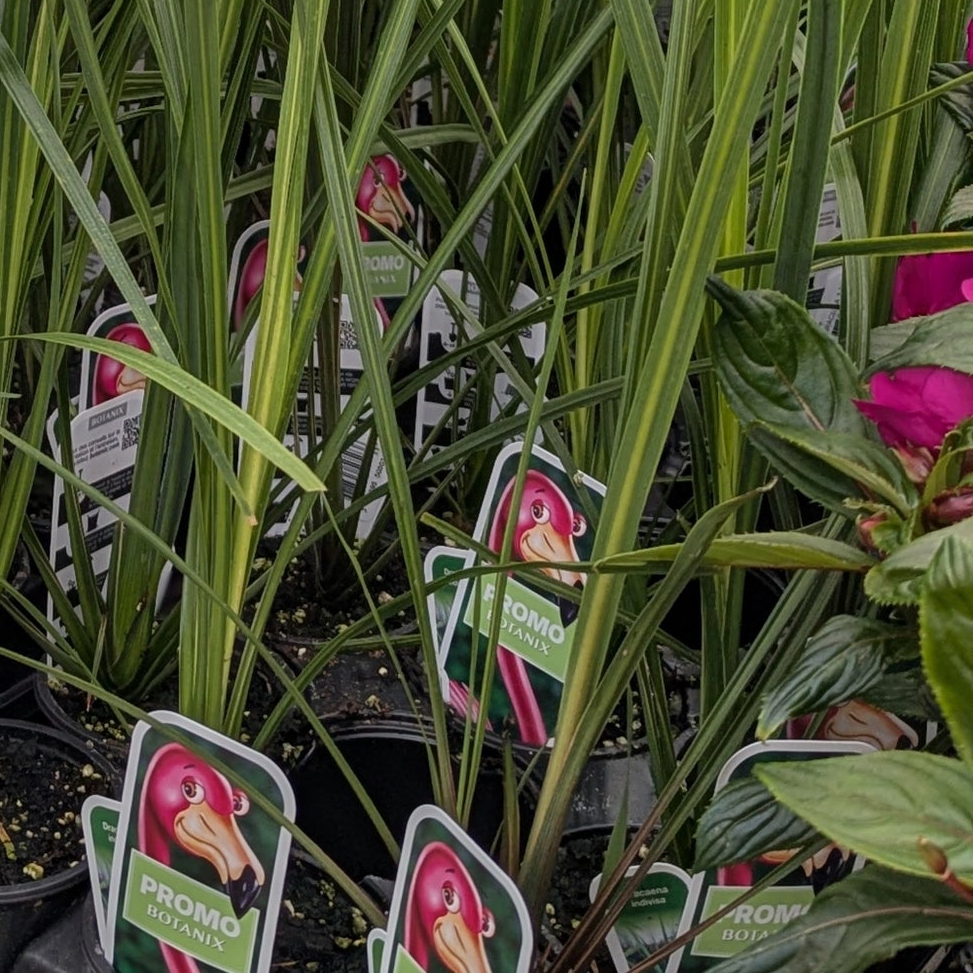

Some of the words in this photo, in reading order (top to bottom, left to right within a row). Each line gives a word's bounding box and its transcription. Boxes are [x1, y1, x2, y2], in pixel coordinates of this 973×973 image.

[91, 406, 124, 427] BOTANIX
[140, 873, 241, 938] PROMO
[717, 904, 811, 924] ROM
[147, 904, 225, 952] BOTANIX
[722, 928, 778, 942] BOTA
